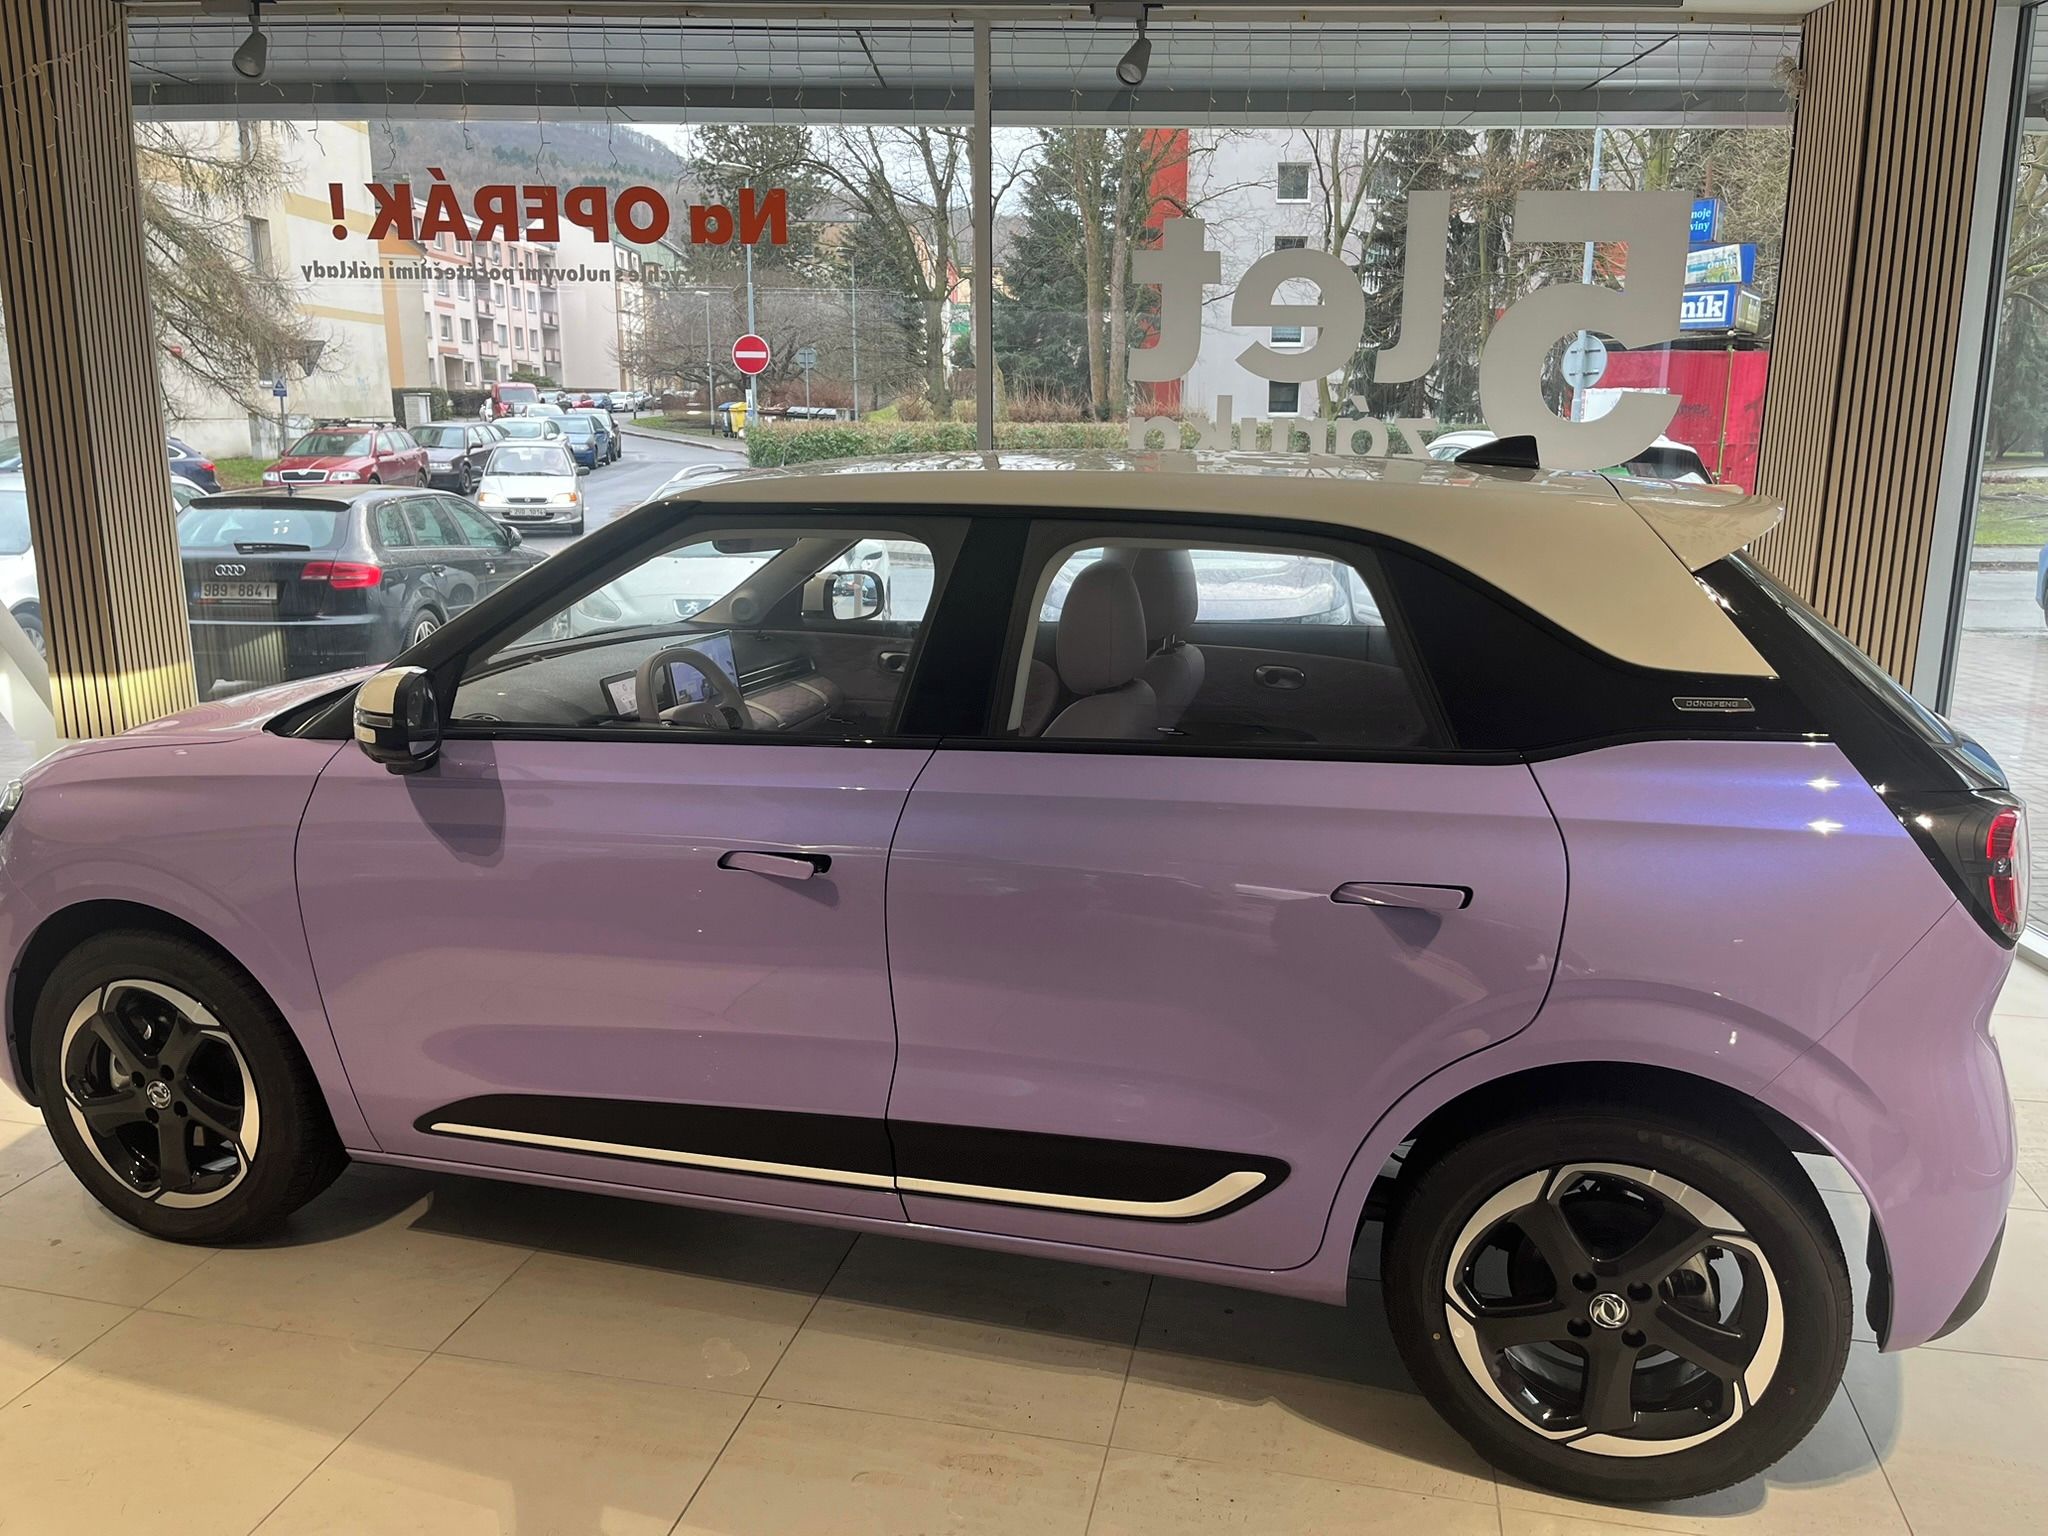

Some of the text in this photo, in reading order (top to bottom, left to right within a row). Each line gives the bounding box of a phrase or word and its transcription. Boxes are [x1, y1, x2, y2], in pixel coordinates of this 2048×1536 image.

[1690, 221, 1710, 233] viny
[1681, 295, 1723, 318] ník
[204, 583, 271, 598] 9B9 8841
[1686, 700, 1739, 708] DONGFENG
